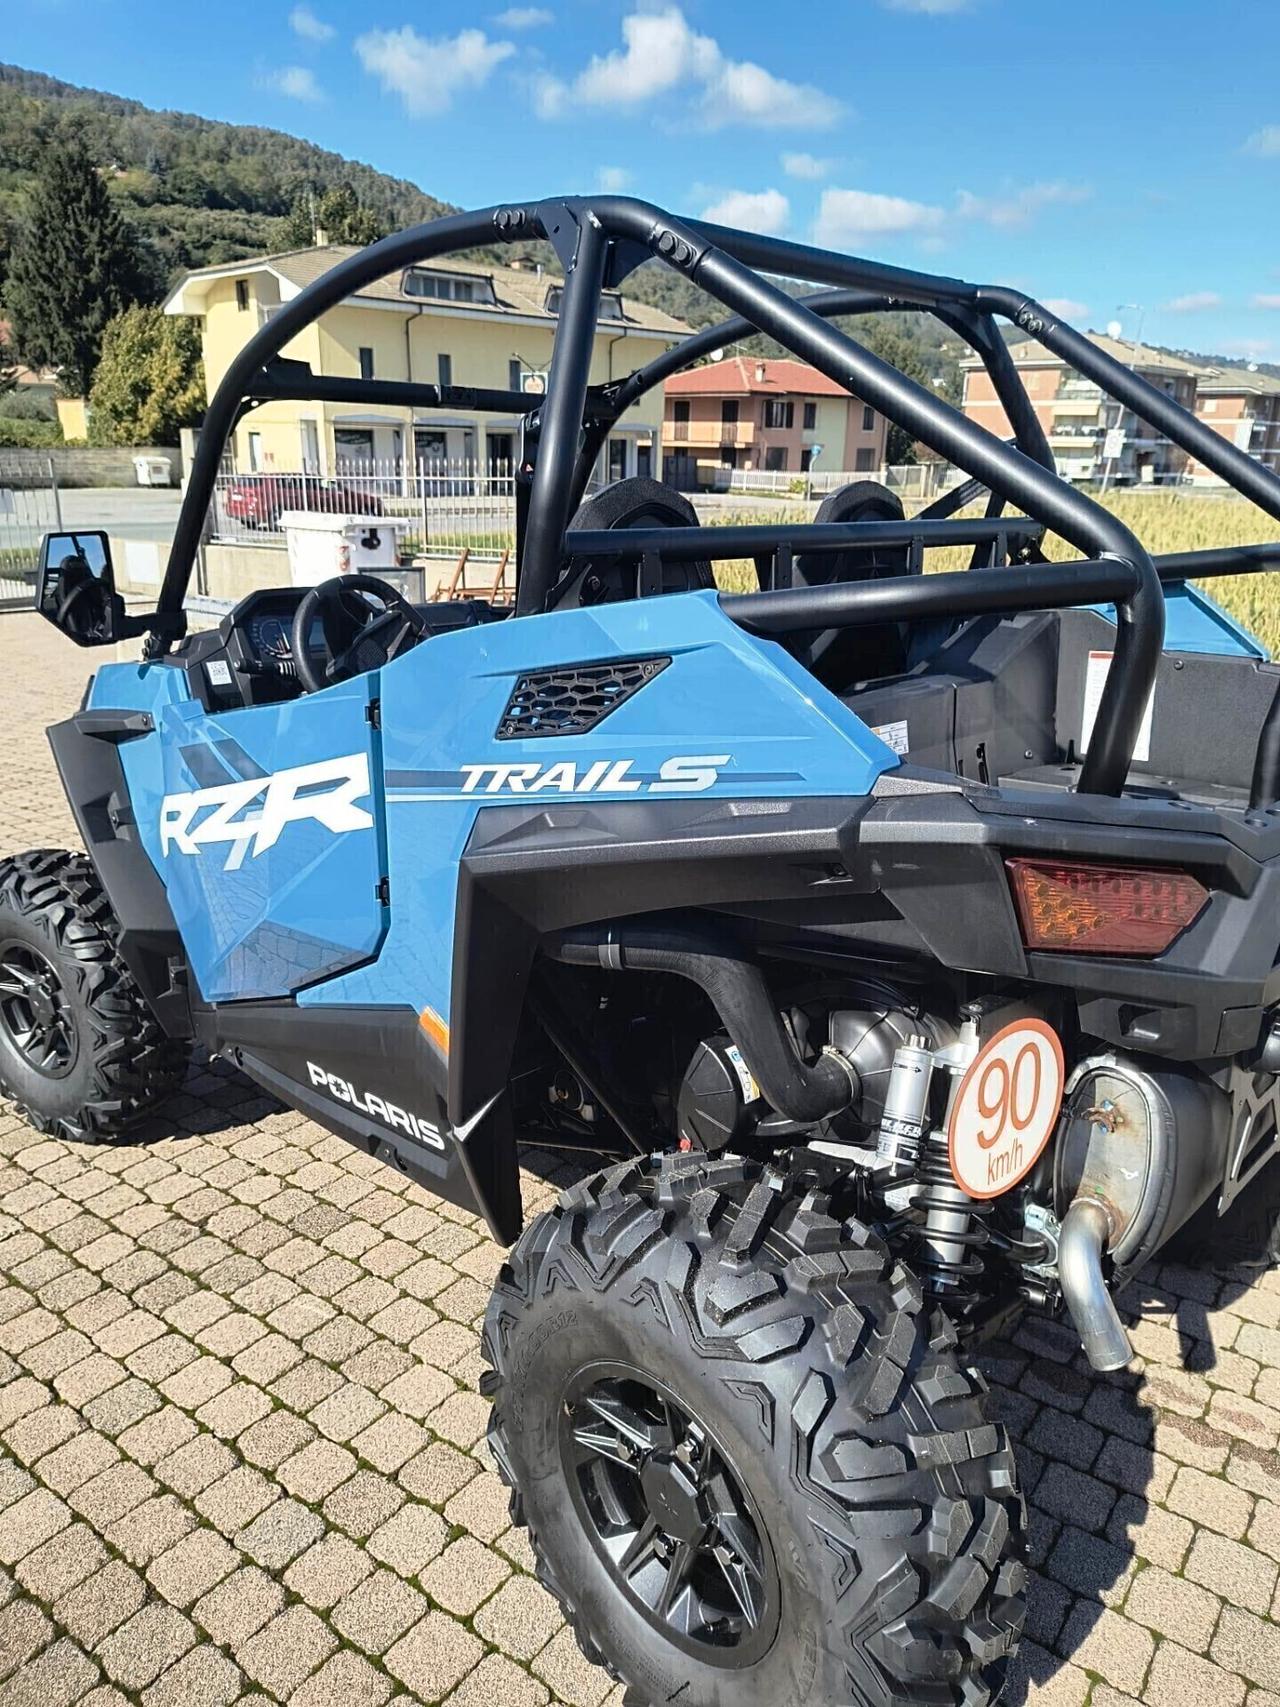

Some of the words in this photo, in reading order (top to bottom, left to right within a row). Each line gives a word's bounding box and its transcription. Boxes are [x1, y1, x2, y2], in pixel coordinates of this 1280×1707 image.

[160, 752, 374, 871] RZR
[459, 760, 642, 793] TRAIL
[647, 754, 732, 793] S
[306, 1060, 446, 1151] POLARIS
[977, 1042, 1042, 1150] 90
[987, 1137, 1024, 1186] km/h
